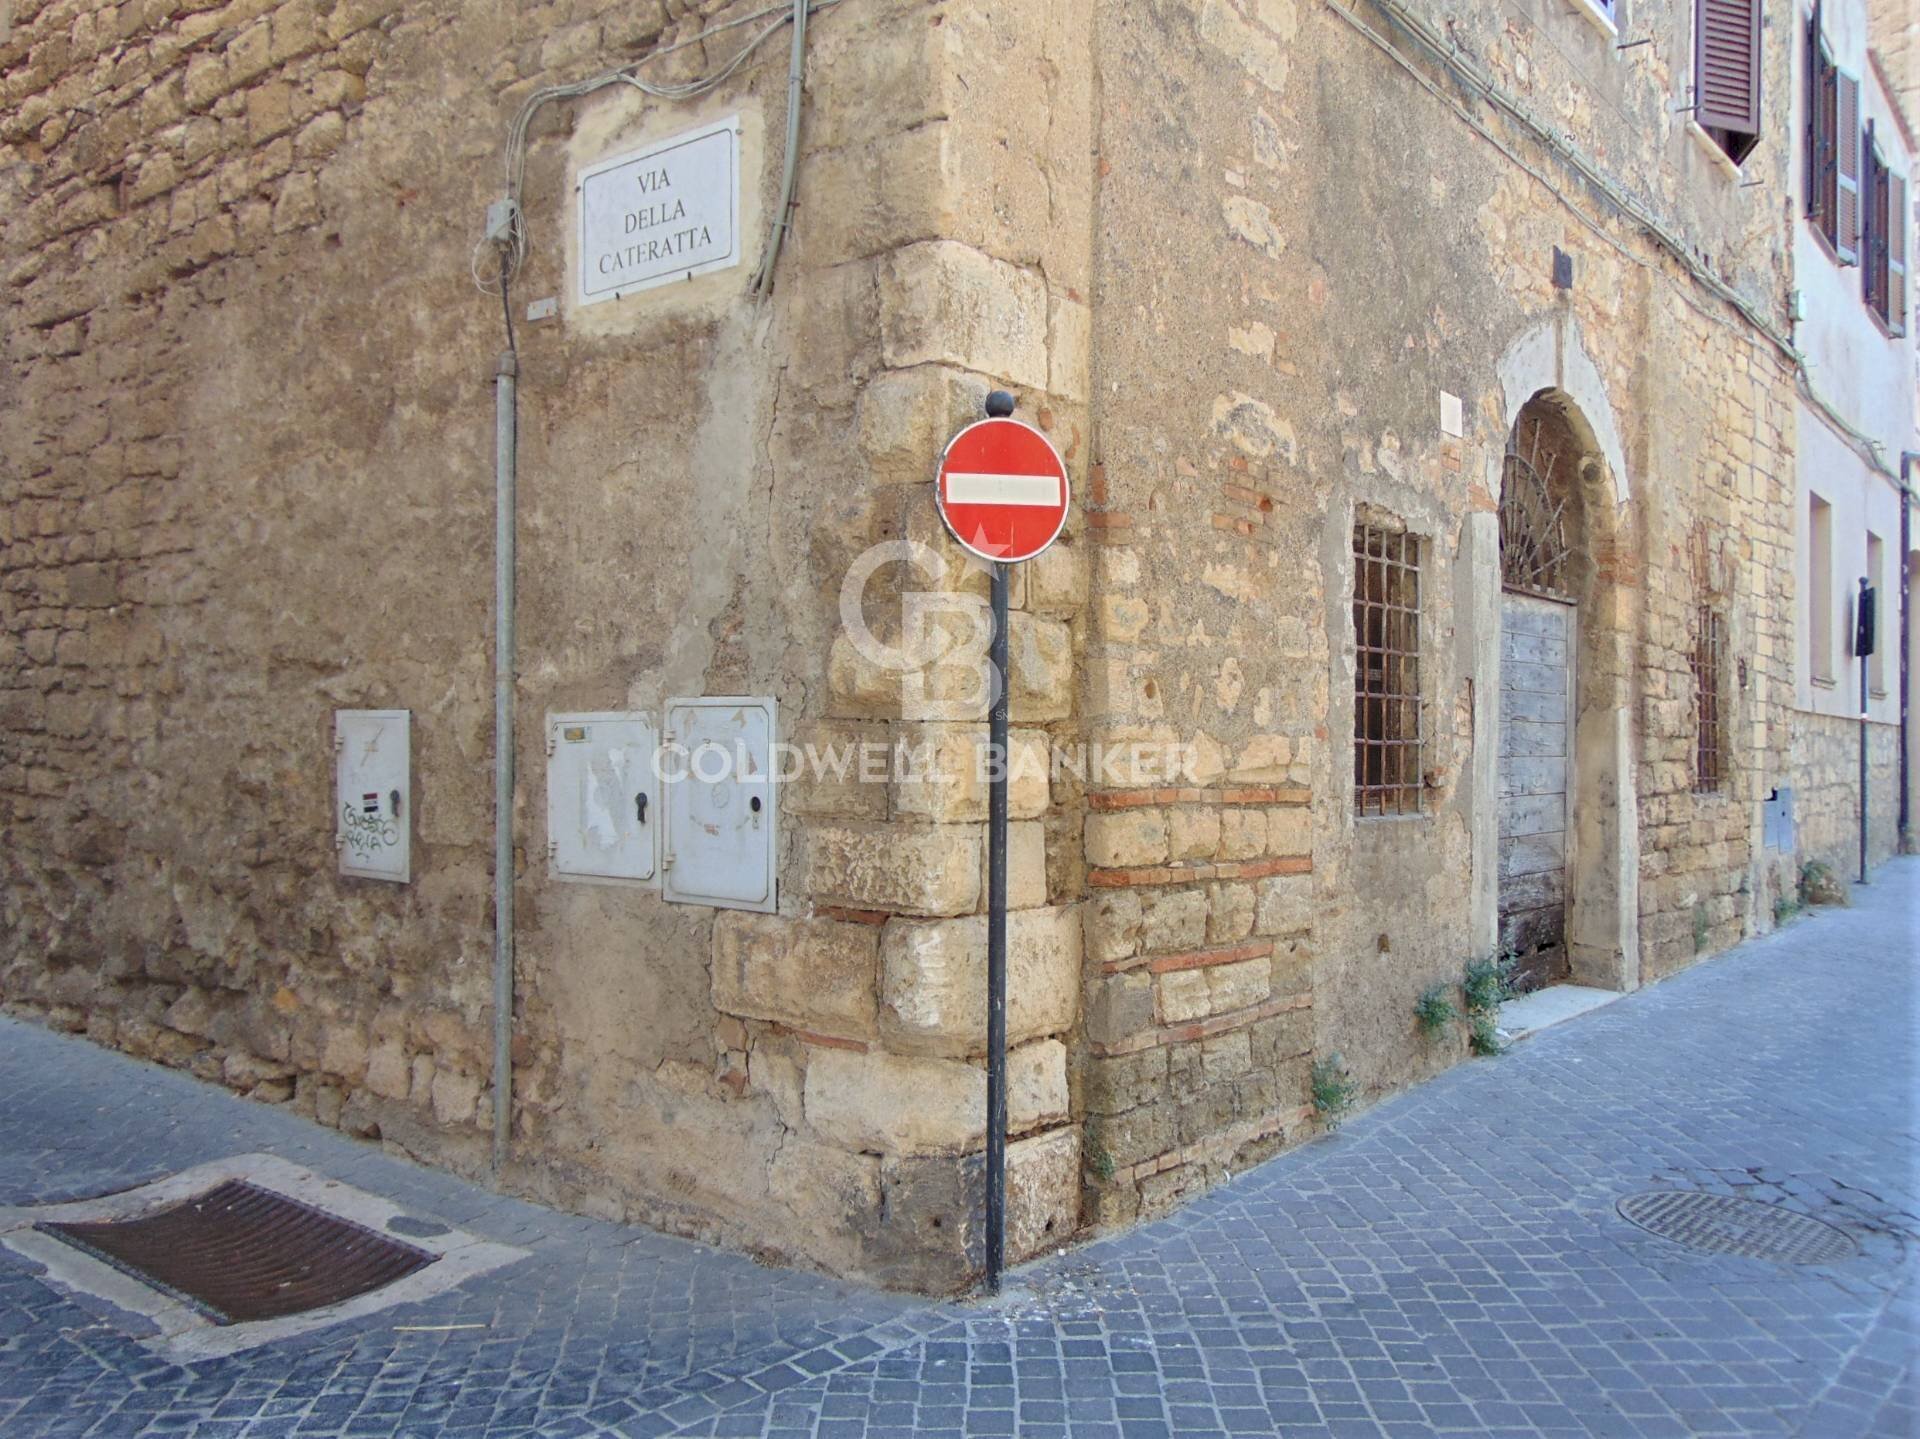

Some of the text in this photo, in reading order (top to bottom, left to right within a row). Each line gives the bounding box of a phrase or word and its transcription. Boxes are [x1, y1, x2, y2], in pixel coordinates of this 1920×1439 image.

[637, 167, 671, 194] VIA
[624, 198, 686, 234] DELLA
[599, 225, 712, 274] CATERATTA
